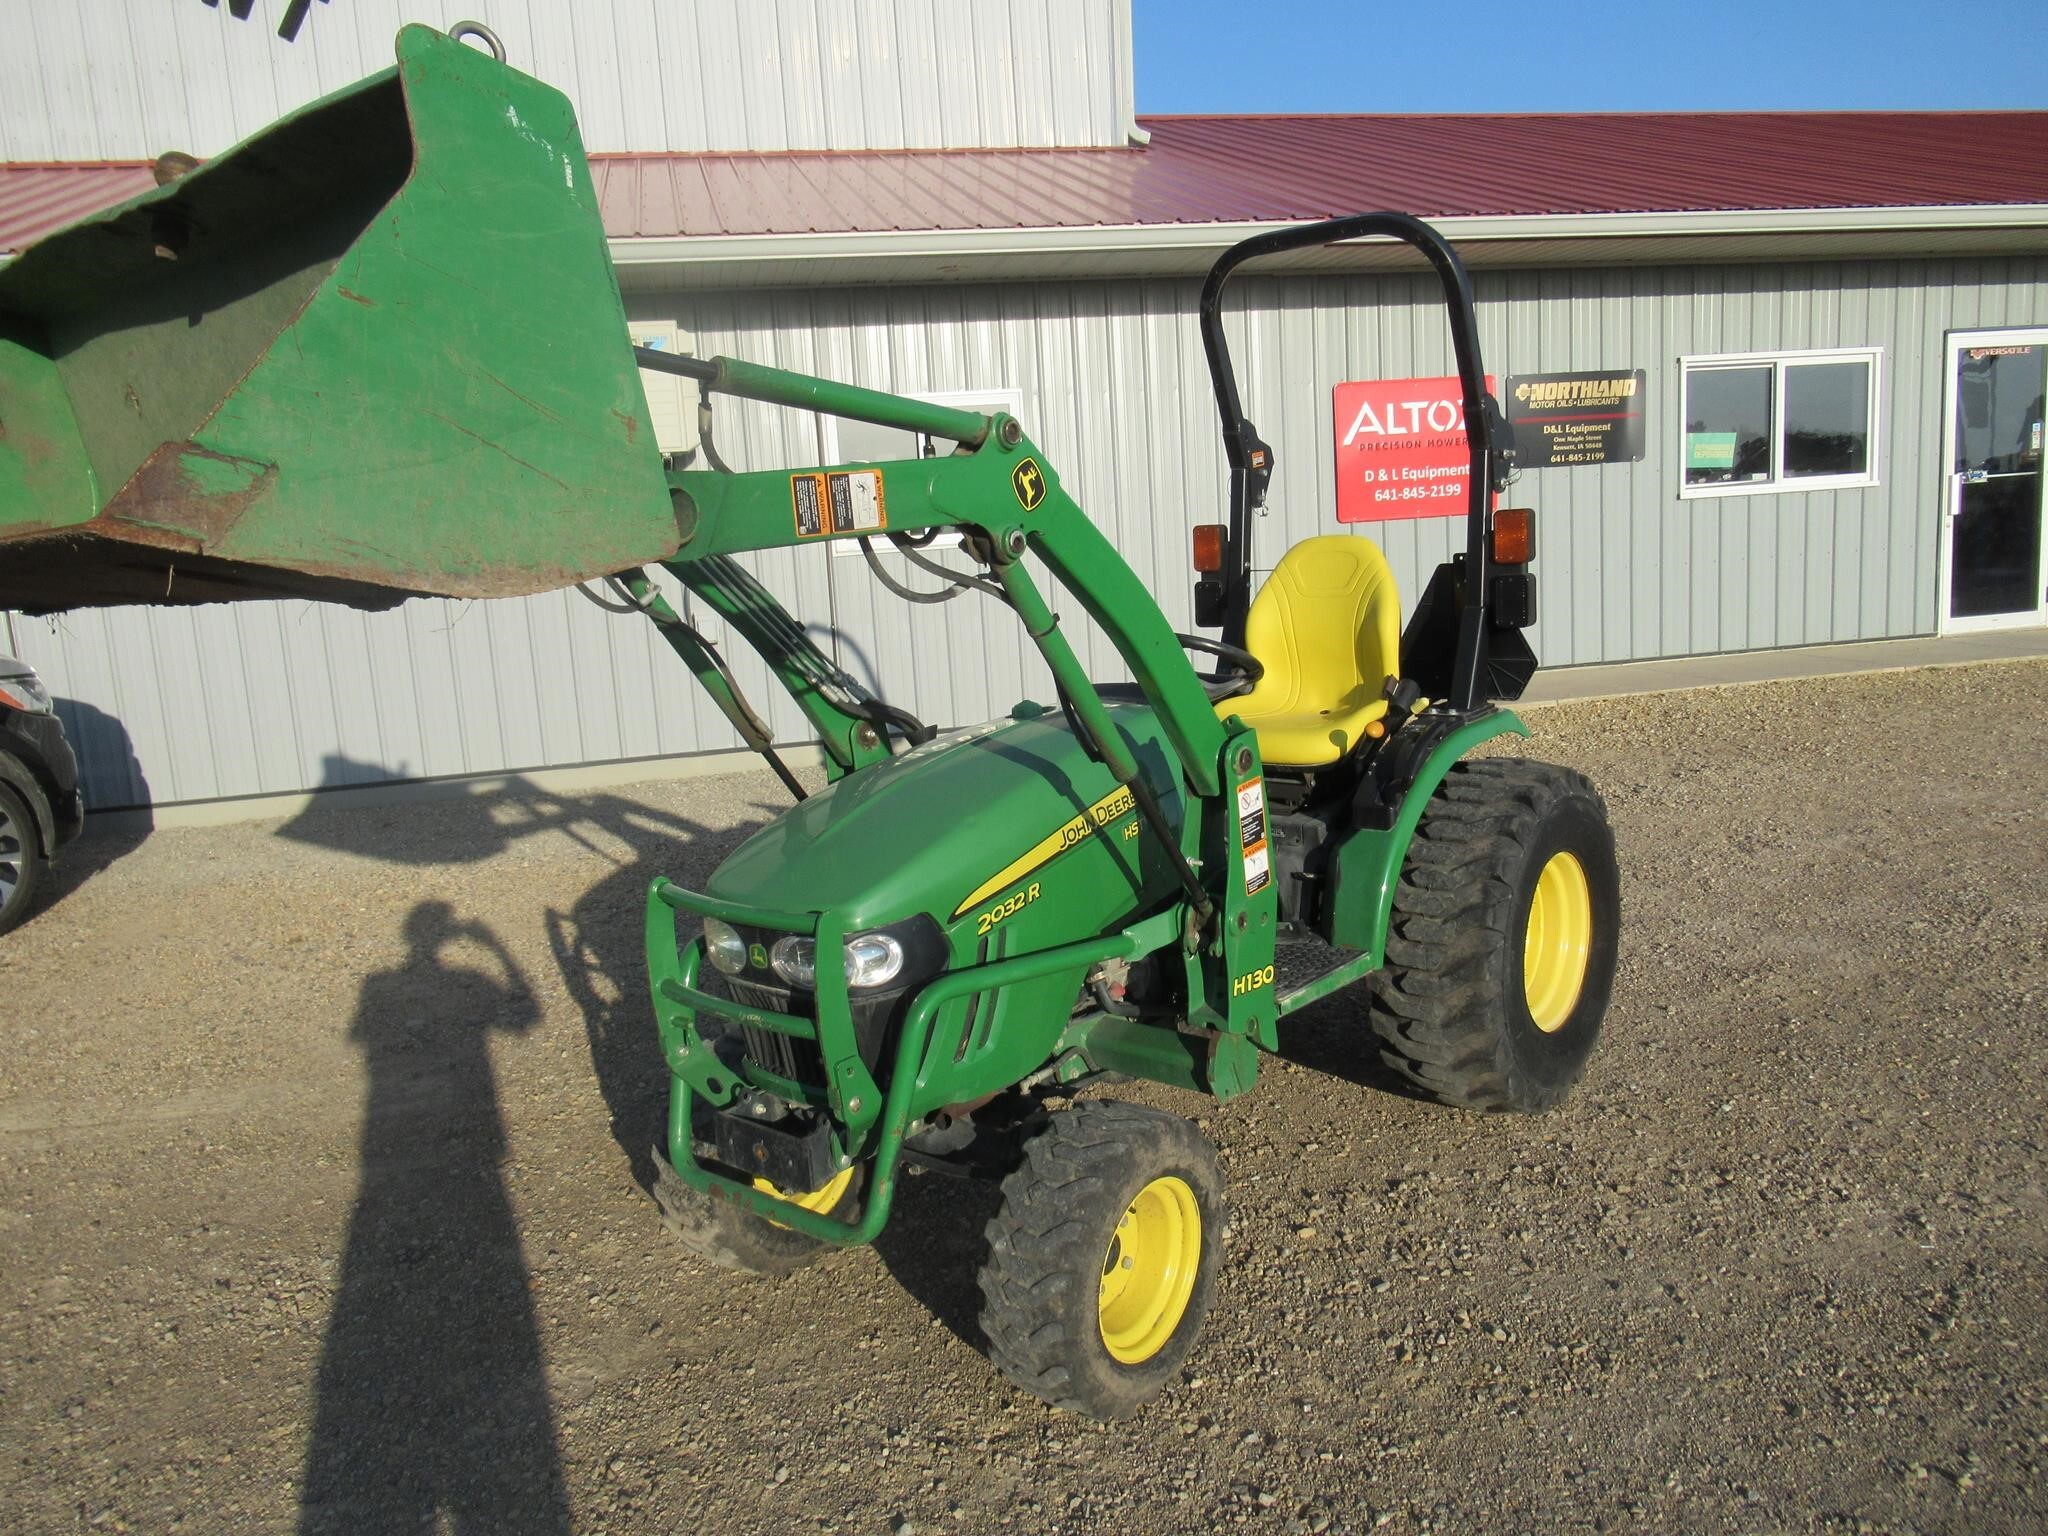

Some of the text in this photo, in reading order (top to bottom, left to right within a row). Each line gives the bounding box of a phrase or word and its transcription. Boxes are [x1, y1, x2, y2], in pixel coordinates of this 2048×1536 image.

[1985, 346, 2032, 356] VERSATILE
[1530, 379, 1637, 400] NORTHLAND
[1529, 397, 1620, 408] MOTOR OILS LUBRICANTS
[1543, 423, 1612, 434] D&L Equipment
[1360, 441, 1421, 452] PRECISION
[1551, 452, 1605, 462] 641-845-2199
[1364, 464, 1470, 482] D & L Equipment
[1375, 484, 1461, 501] 641-845-2199
[818, 489, 829, 529] WARNING
[1060, 792, 1137, 850] JOHN DEERE
[977, 882, 1041, 937] 2032 R
[1233, 965, 1275, 997] H130
